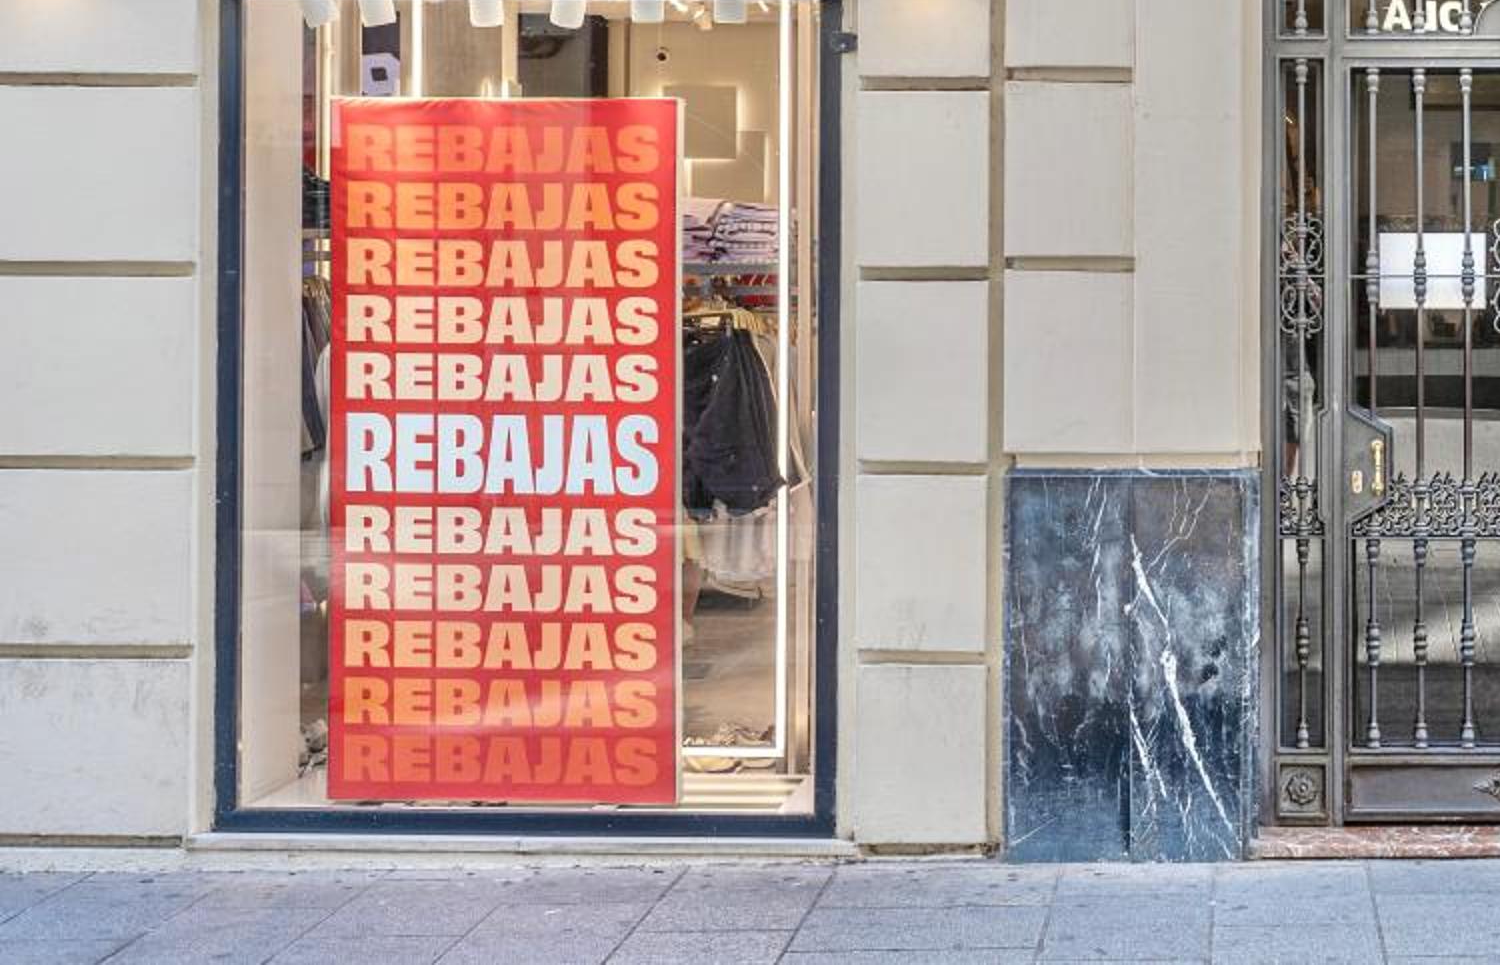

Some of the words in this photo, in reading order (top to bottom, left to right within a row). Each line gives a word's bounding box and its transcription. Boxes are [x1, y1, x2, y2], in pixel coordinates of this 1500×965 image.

[346, 123, 659, 174] REBAJAS
[346, 181, 659, 232] REBAJAS
[346, 238, 659, 289] REBAJAS
[346, 294, 659, 346] REBAJAS
[346, 352, 659, 403] REBAJAS
[346, 412, 659, 495] REBAJAS
[344, 506, 659, 557] REBAJAS
[344, 563, 659, 614] REBAJAS
[344, 619, 659, 672] REBAJAS
[344, 676, 659, 729] REBAJAS
[344, 737, 659, 786] REBAJAS
